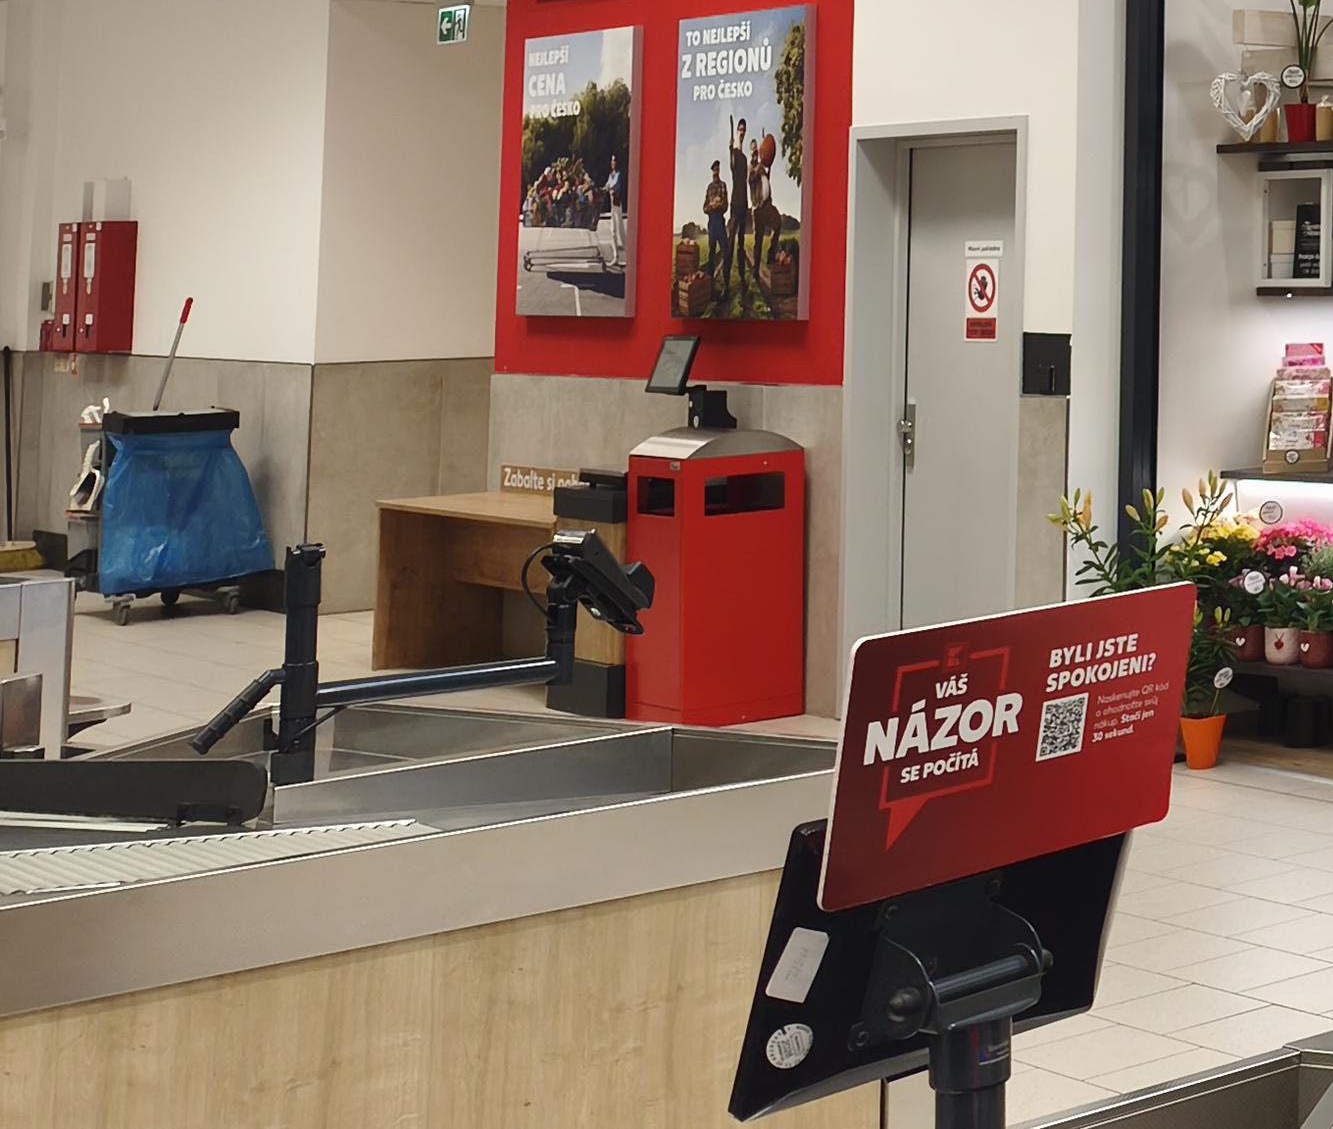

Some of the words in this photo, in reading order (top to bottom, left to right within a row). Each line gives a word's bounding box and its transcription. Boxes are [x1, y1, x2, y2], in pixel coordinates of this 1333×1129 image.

[686, 30, 700, 48] TO
[703, 20, 751, 45] NEJLEPŠÍ
[528, 45, 569, 67] NEJLEPŠÍ
[681, 55, 692, 79] Z
[696, 37, 772, 78] REGIONŮ
[528, 71, 566, 97] CENA
[693, 84, 715, 102] PRO
[718, 79, 752, 98] ČESKO
[551, 99, 581, 119] ČESKO
[504, 468, 544, 490] Zabalte
[1050, 647, 1092, 668] BYLI
[1095, 634, 1138, 660] JSTE
[1046, 653, 1157, 692] SPOKOJENI?
[935, 674, 968, 699] VÁŠ
[863, 693, 1023, 766] NÁZOR
[1092, 731, 1103, 743] 30
[900, 766, 919, 784] SE
[923, 748, 979, 779] POČÍTÁ
